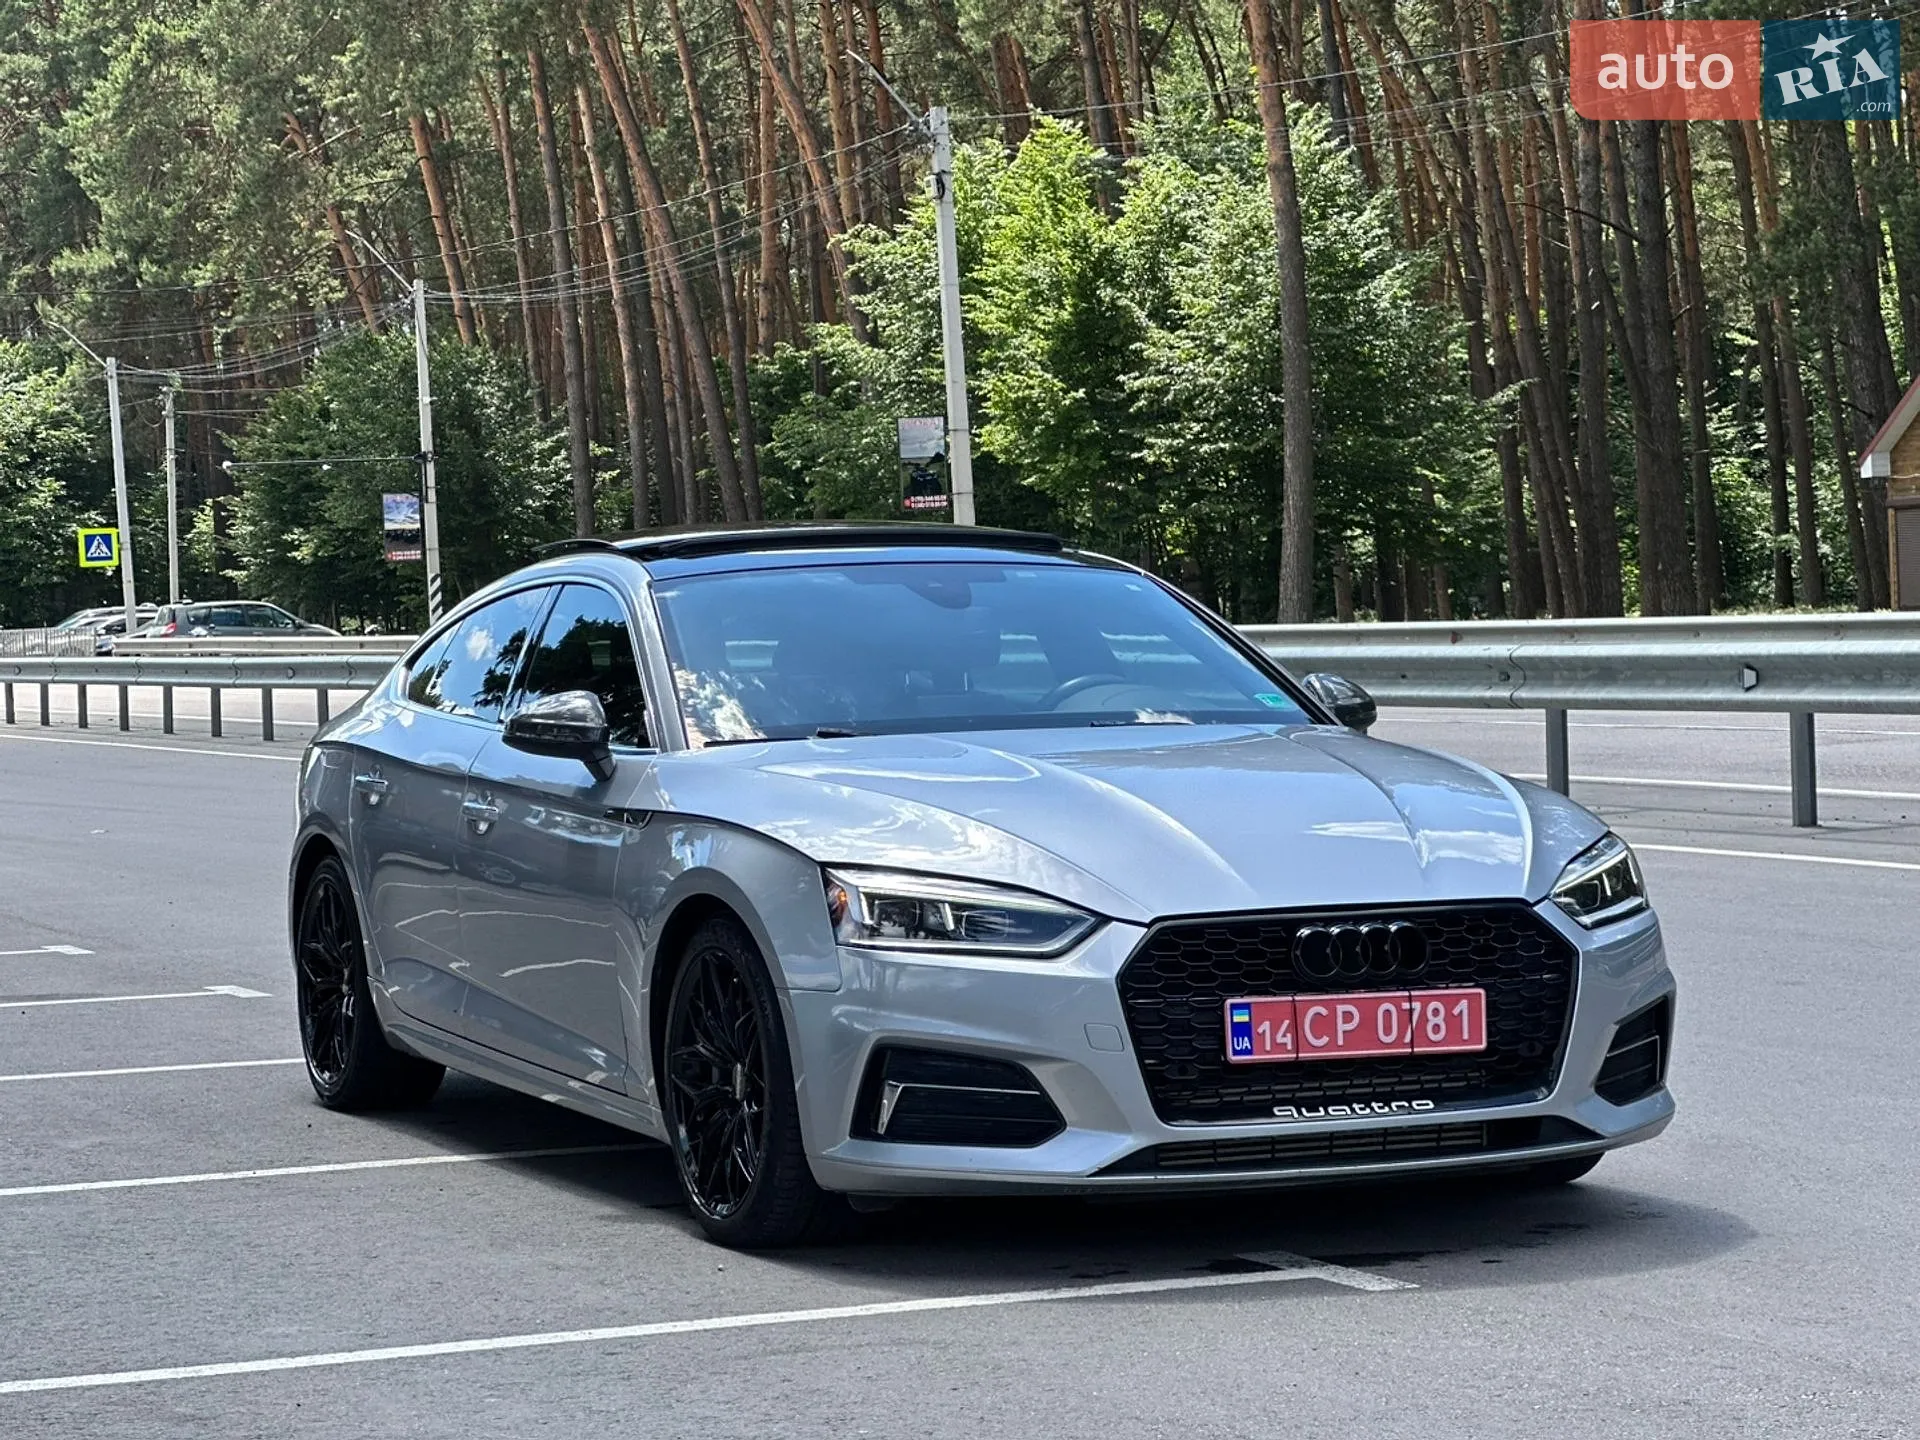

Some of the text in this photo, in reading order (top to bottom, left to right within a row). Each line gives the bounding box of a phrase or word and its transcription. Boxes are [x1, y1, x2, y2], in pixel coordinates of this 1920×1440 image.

[1257, 999, 1470, 1052] 14 CP 0781
[1233, 1037, 1251, 1050] UA
[1273, 1100, 1435, 1118] quattro
